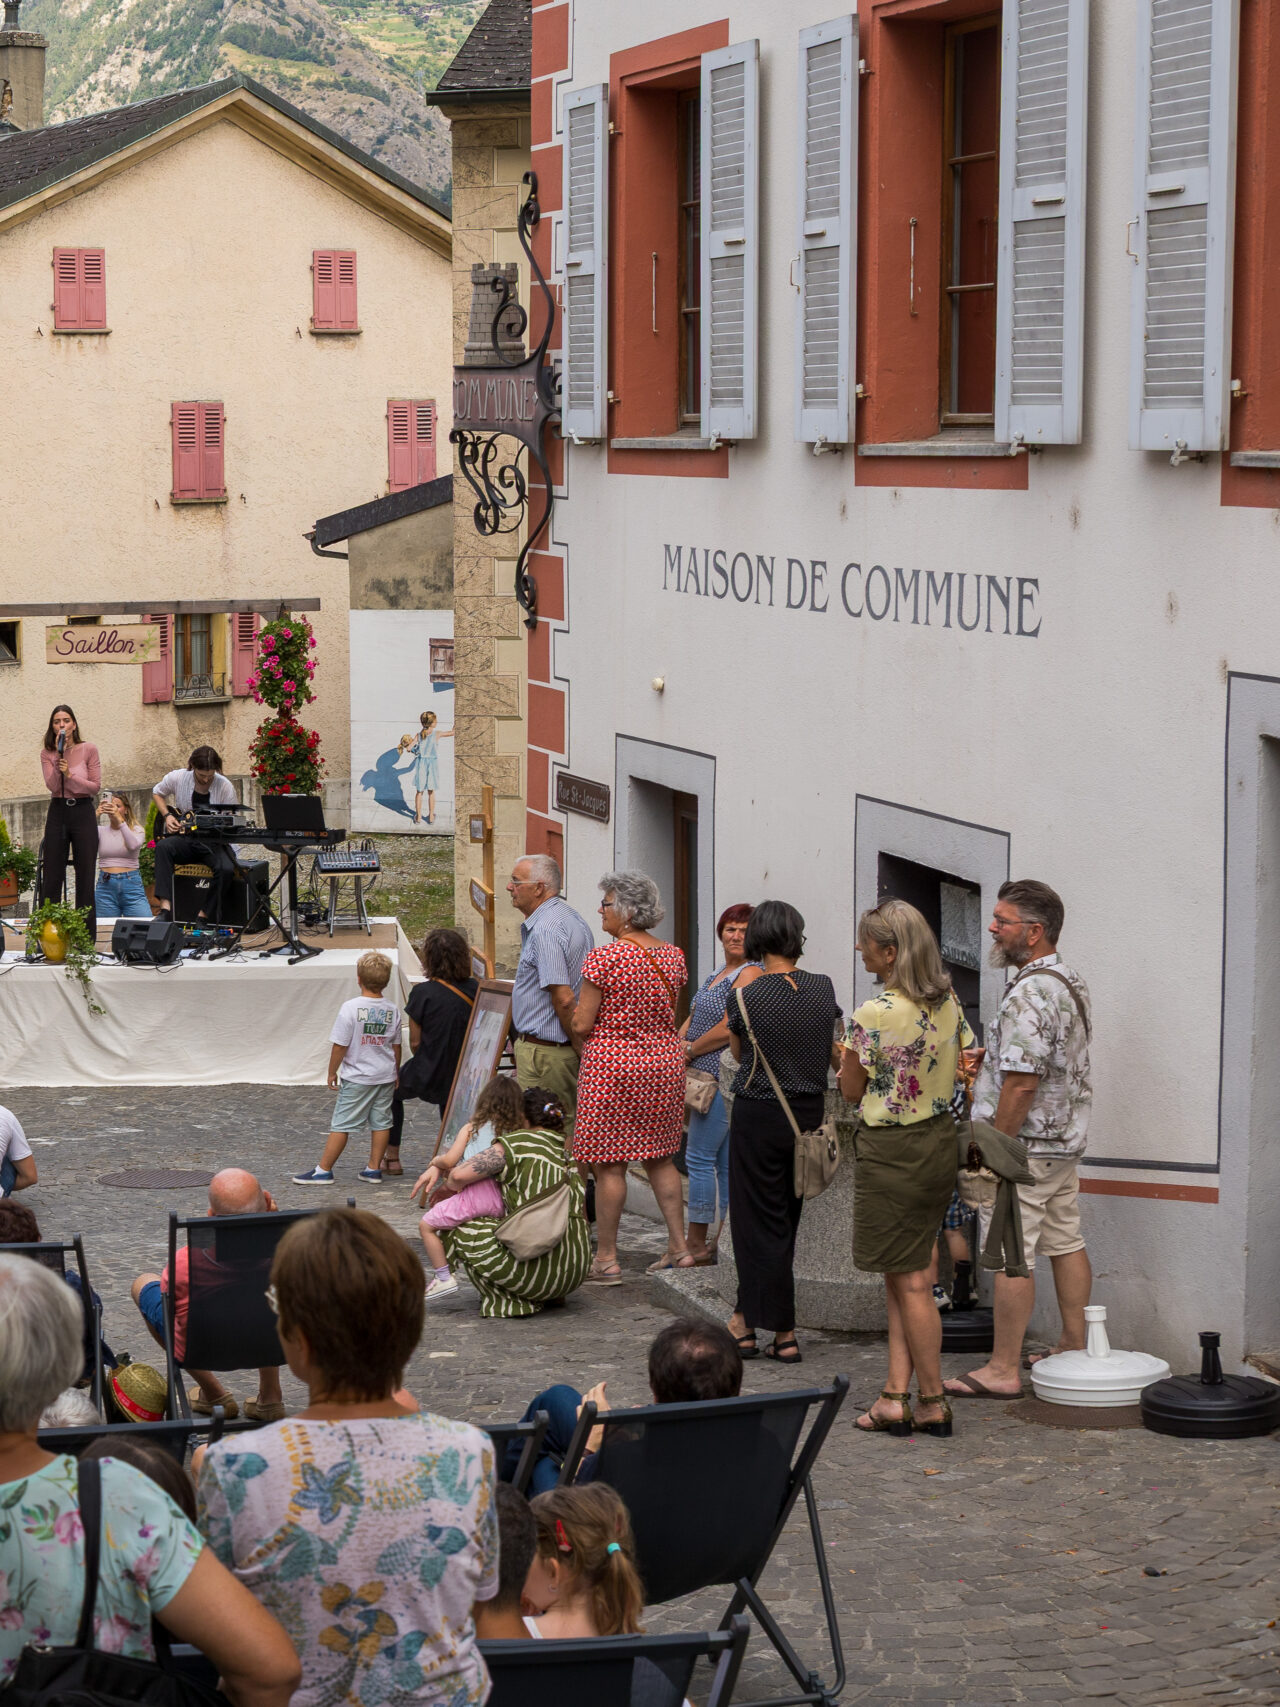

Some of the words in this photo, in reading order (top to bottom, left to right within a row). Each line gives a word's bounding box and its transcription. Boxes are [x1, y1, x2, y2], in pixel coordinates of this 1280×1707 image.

[662, 544, 776, 606] MAISON
[786, 558, 830, 613] DE
[841, 562, 1042, 638] COMMUNE
[56, 630, 136, 655] Saillon
[559, 780, 569, 801] Rue
